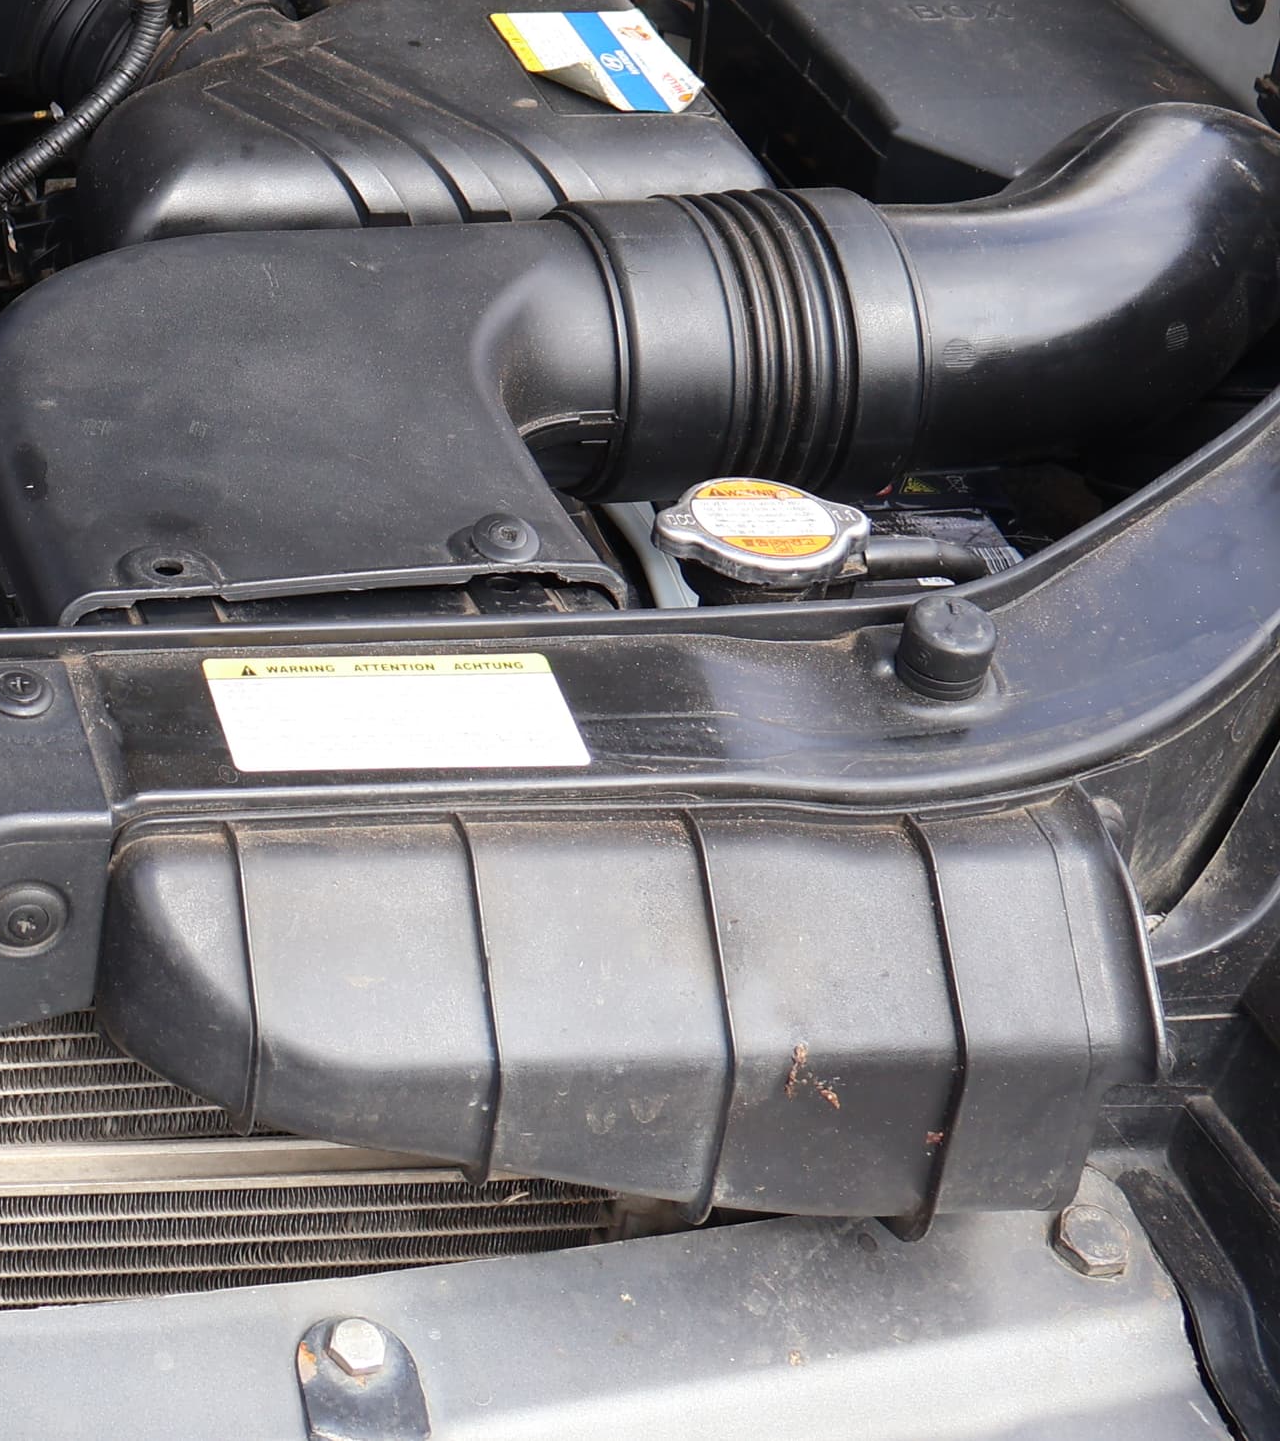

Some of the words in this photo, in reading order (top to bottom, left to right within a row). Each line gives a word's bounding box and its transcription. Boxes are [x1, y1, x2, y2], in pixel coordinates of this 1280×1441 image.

[908, 2, 1016, 22] BOX
[265, 663, 337, 674] WARNING
[352, 662, 436, 673] ATTENTION
[453, 660, 525, 671] ACHTUNG
